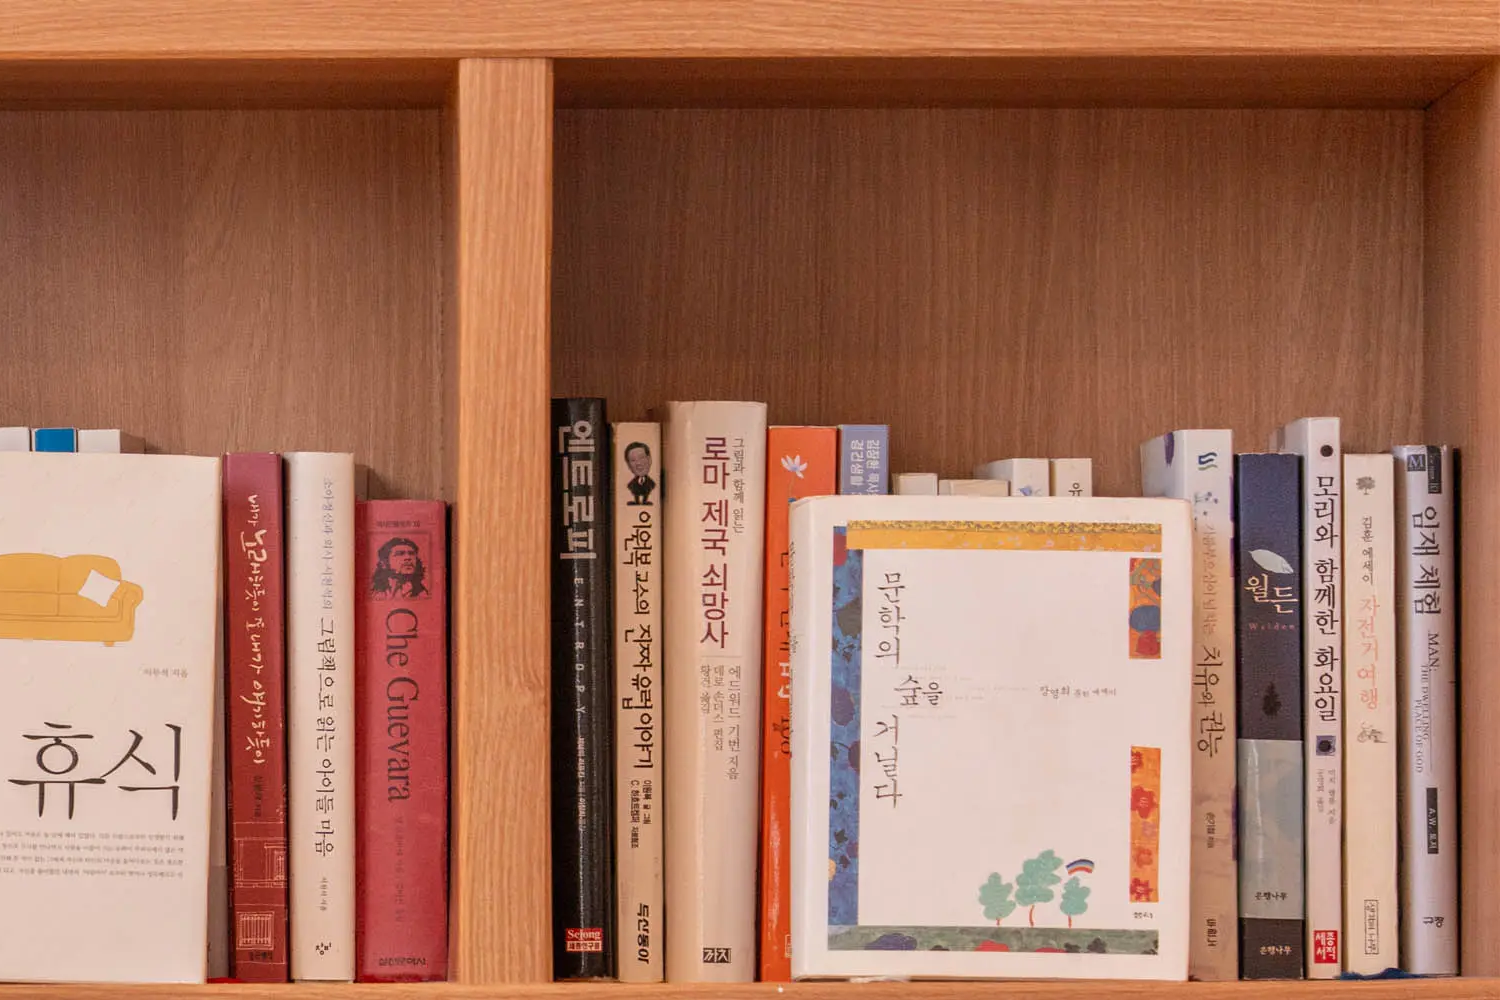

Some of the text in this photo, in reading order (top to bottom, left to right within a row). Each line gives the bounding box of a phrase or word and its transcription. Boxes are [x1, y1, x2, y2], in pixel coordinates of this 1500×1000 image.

[558, 420, 597, 560] 엔트로피
[623, 511, 652, 565] 이원복
[700, 437, 730, 648] 로마 제국 쇠망사
[1412, 506, 1440, 556] 임재
[634, 571, 650, 615] 교수의
[877, 572, 906, 664] 문학의
[1244, 573, 1298, 614] 월든
[1313, 475, 1338, 722] 모리와 함께한 화요일
[1412, 565, 1441, 615] 체험
[625, 624, 653, 672] 진짜
[1357, 595, 1380, 710] 자전거 여행
[1427, 633, 1440, 671] MAN:
[385, 608, 419, 803] Che Guevara
[622, 674, 653, 710] 유럽
[894, 675, 943, 707] 숲을
[1193, 647, 1225, 758] 치유와 권능
[1421, 687, 1430, 740] DWELLING
[315, 618, 336, 857] 그림책으로 읽는 아이들 마음
[873, 715, 902, 809] 거닐다
[1415, 700, 1424, 773] PLACE OF GOD
[8, 721, 182, 821] 휴식
[567, 929, 601, 942] Sejong
